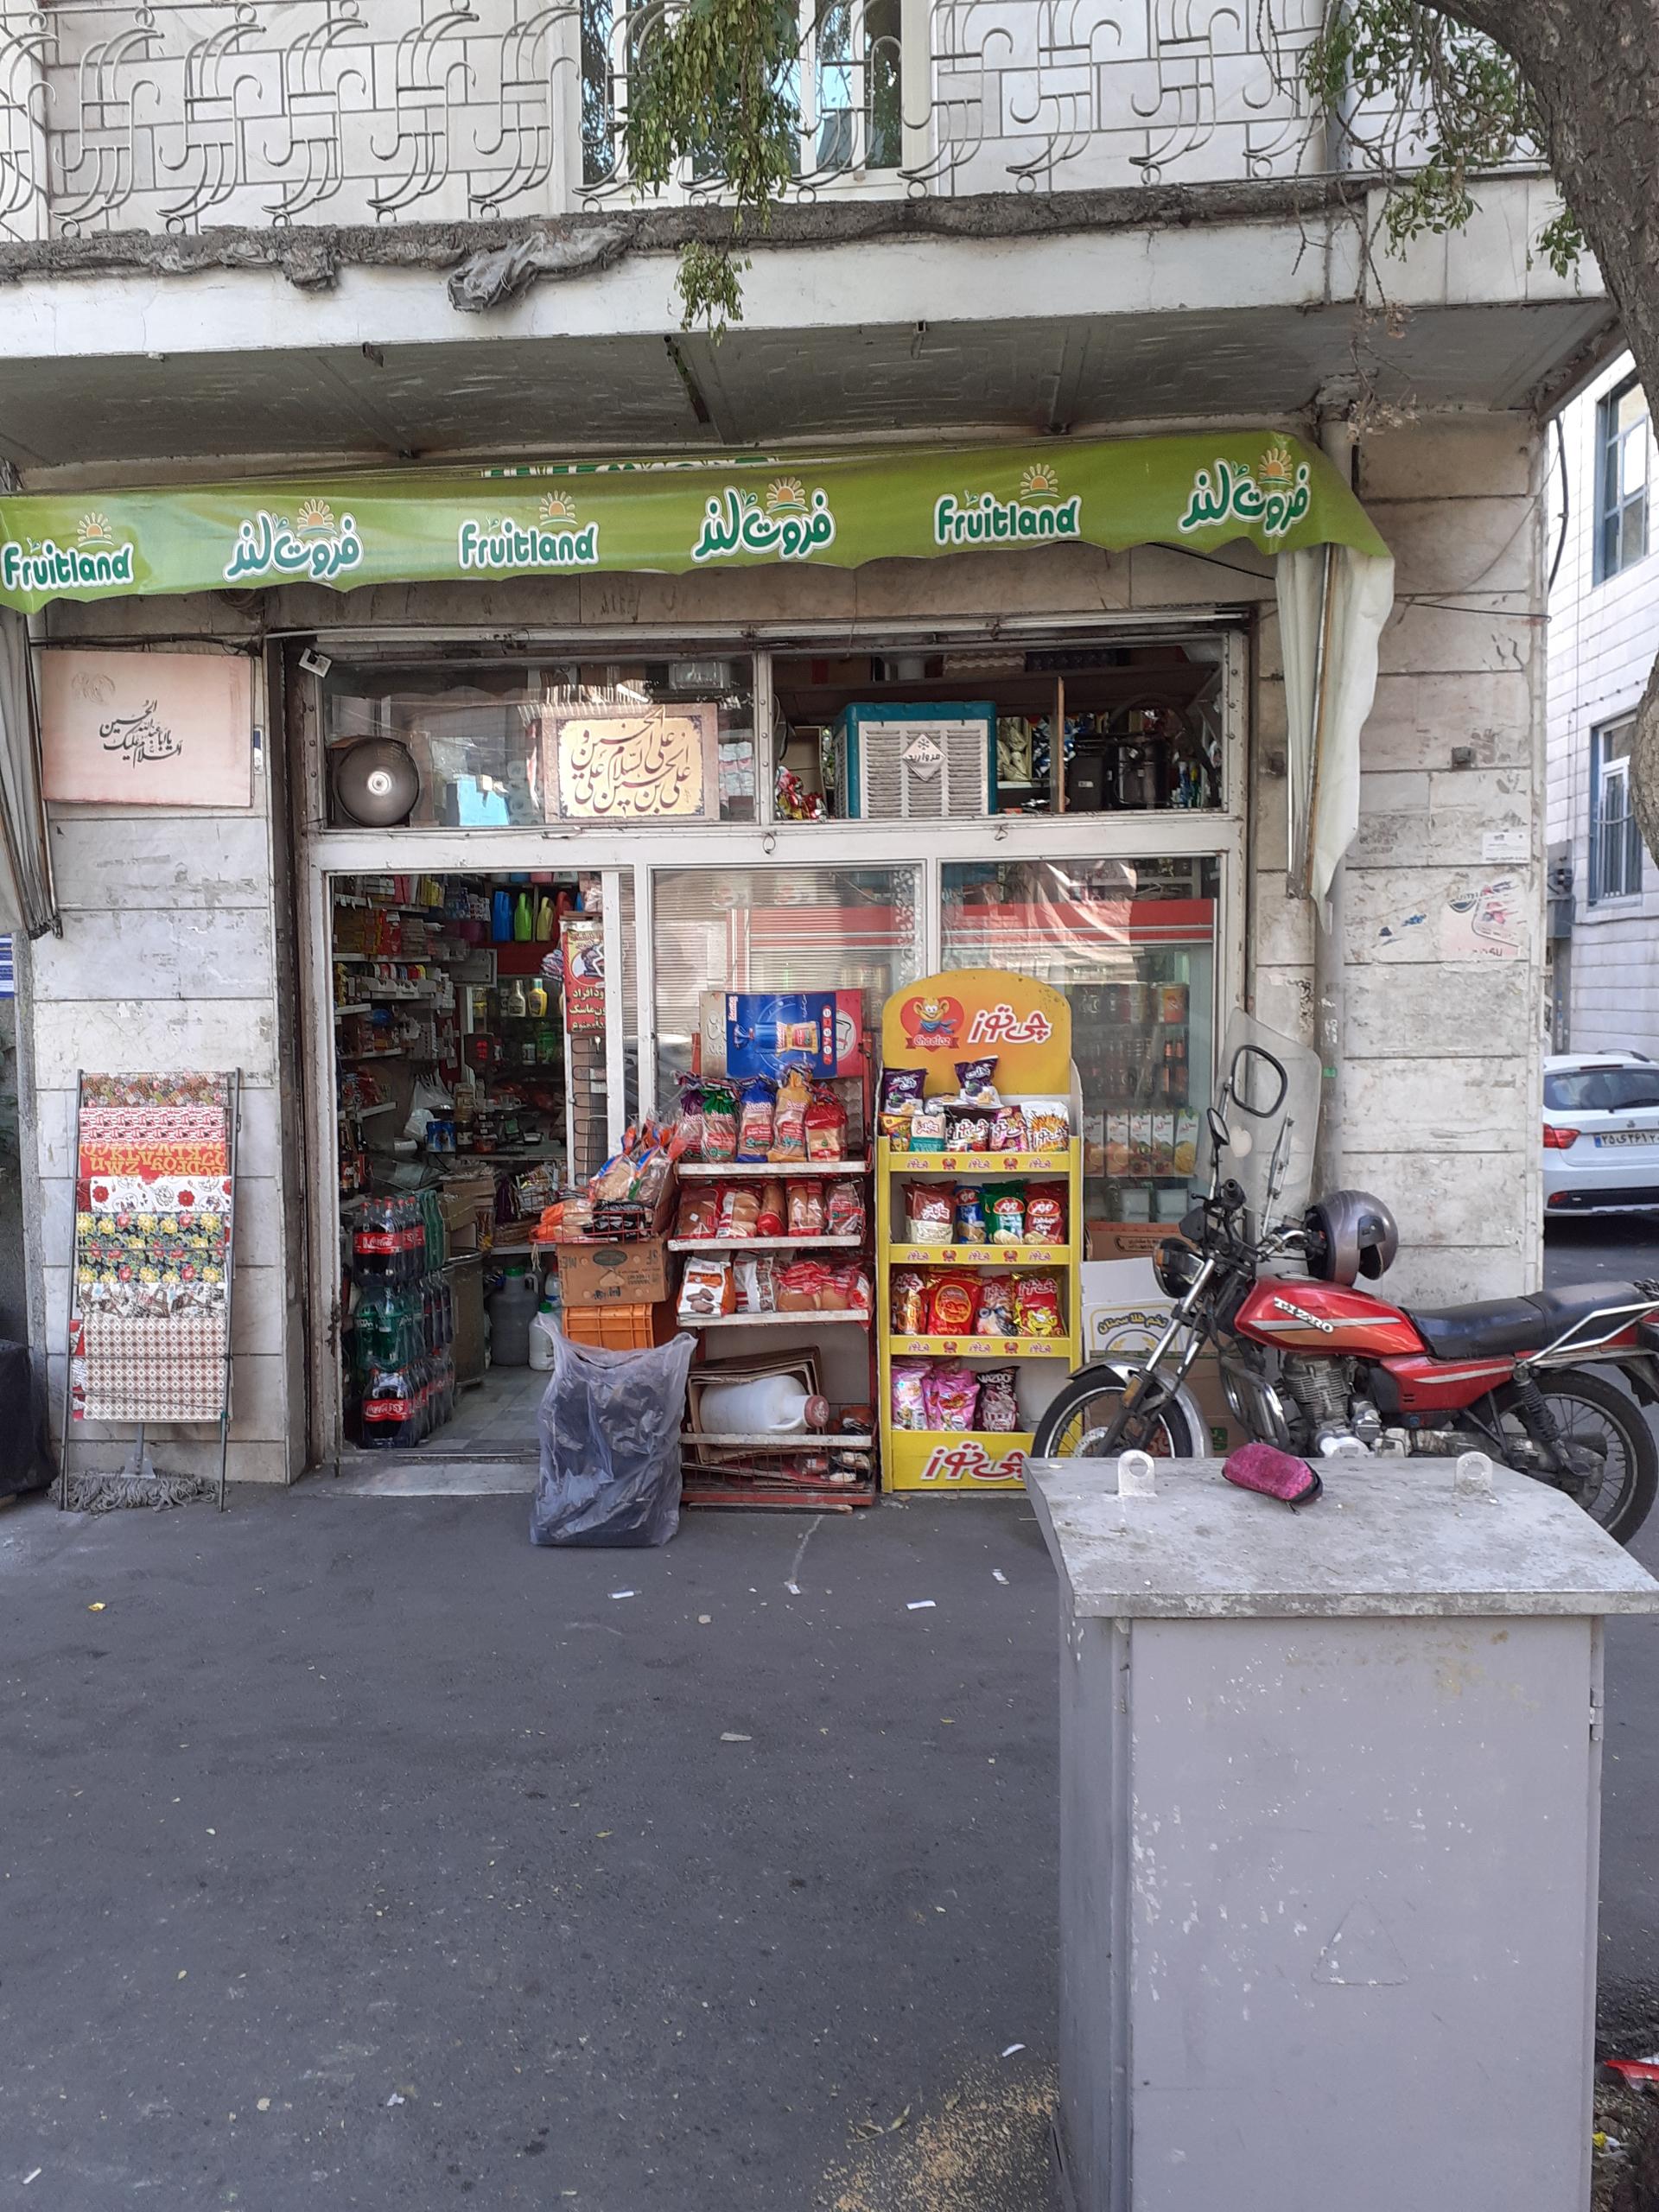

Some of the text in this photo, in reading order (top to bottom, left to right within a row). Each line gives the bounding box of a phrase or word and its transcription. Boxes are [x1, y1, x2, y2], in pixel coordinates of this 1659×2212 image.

[459, 518, 600, 569] Fruitland
[934, 496, 1081, 545] Fruitland
[2, 537, 133, 591] Fruitland
[907, 752, 941, 762] مروارید
[1274, 1296, 1334, 1334] TIZRO
